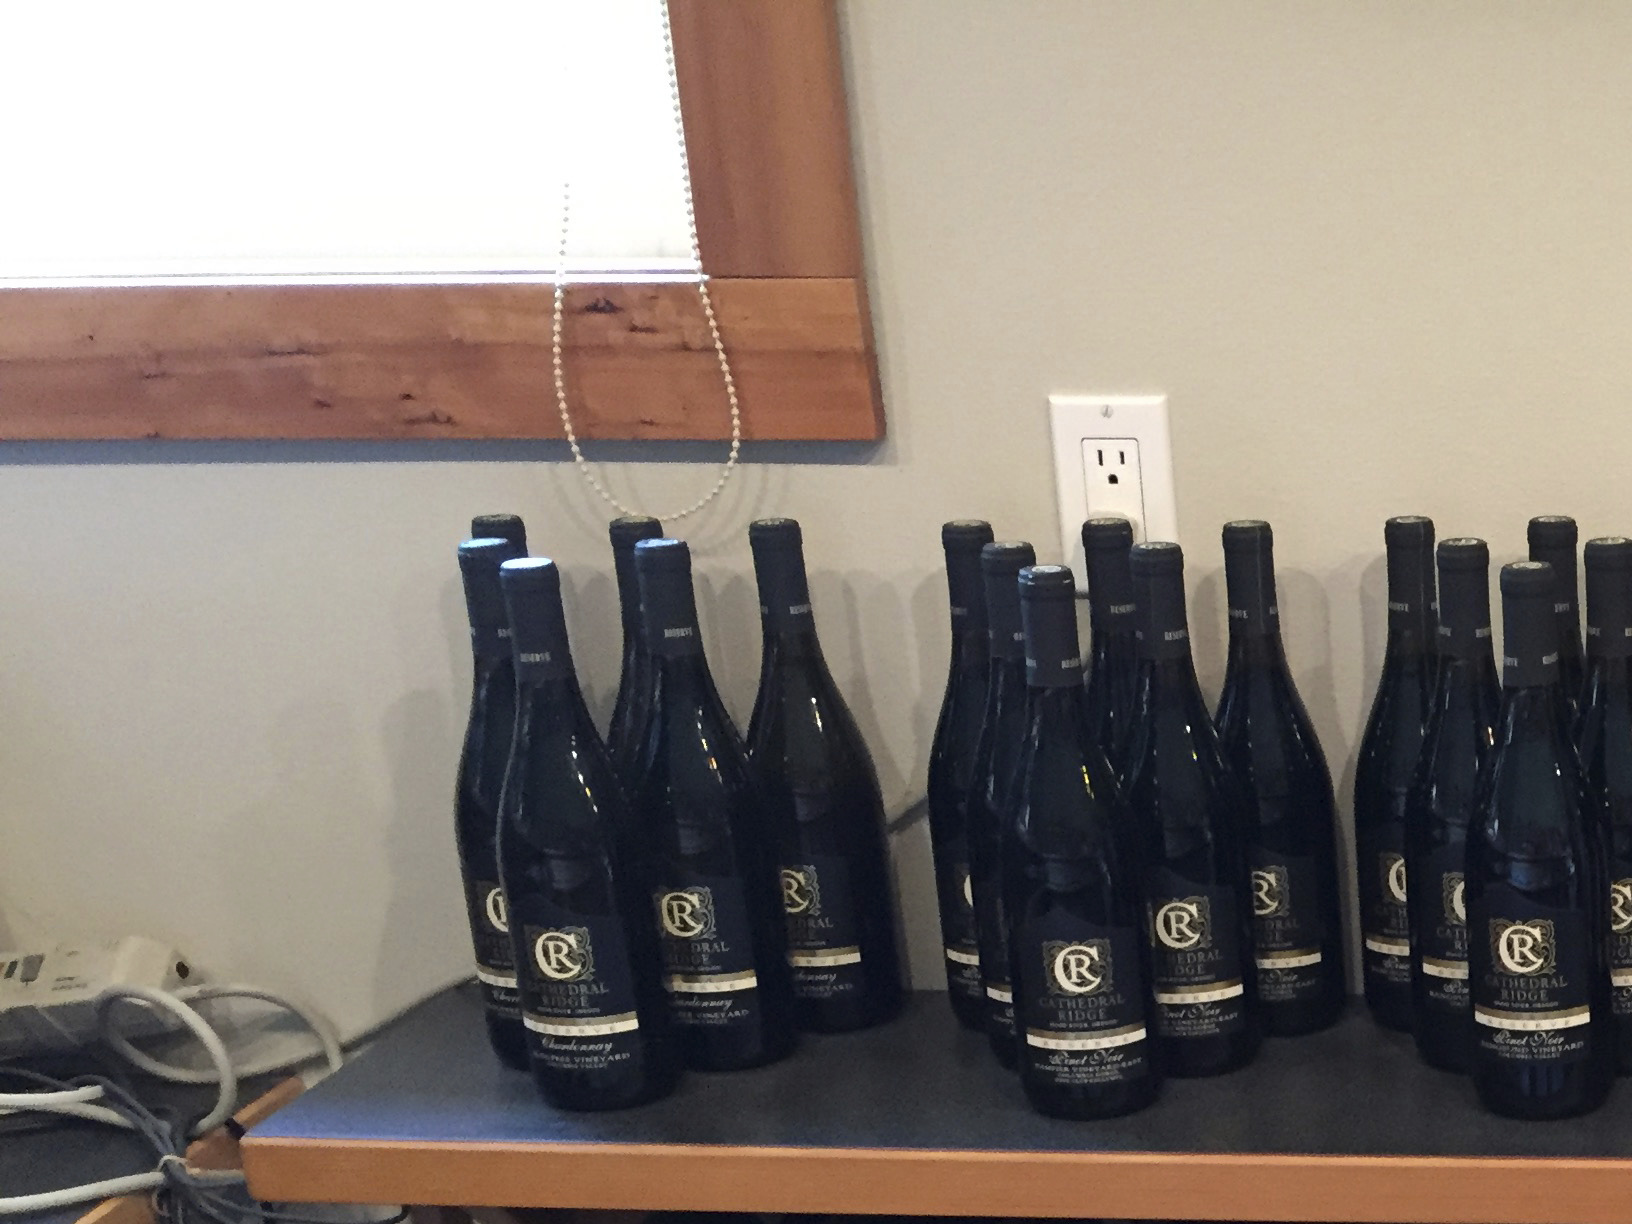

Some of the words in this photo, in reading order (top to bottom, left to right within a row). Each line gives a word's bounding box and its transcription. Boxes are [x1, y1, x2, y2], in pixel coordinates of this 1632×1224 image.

[661, 892, 704, 938] CR
[1156, 902, 1201, 949] CR
[535, 932, 581, 979] CR
[1054, 945, 1102, 993] CR
[1498, 925, 1545, 973] CR
[1501, 988, 1550, 1002] RIDGE
